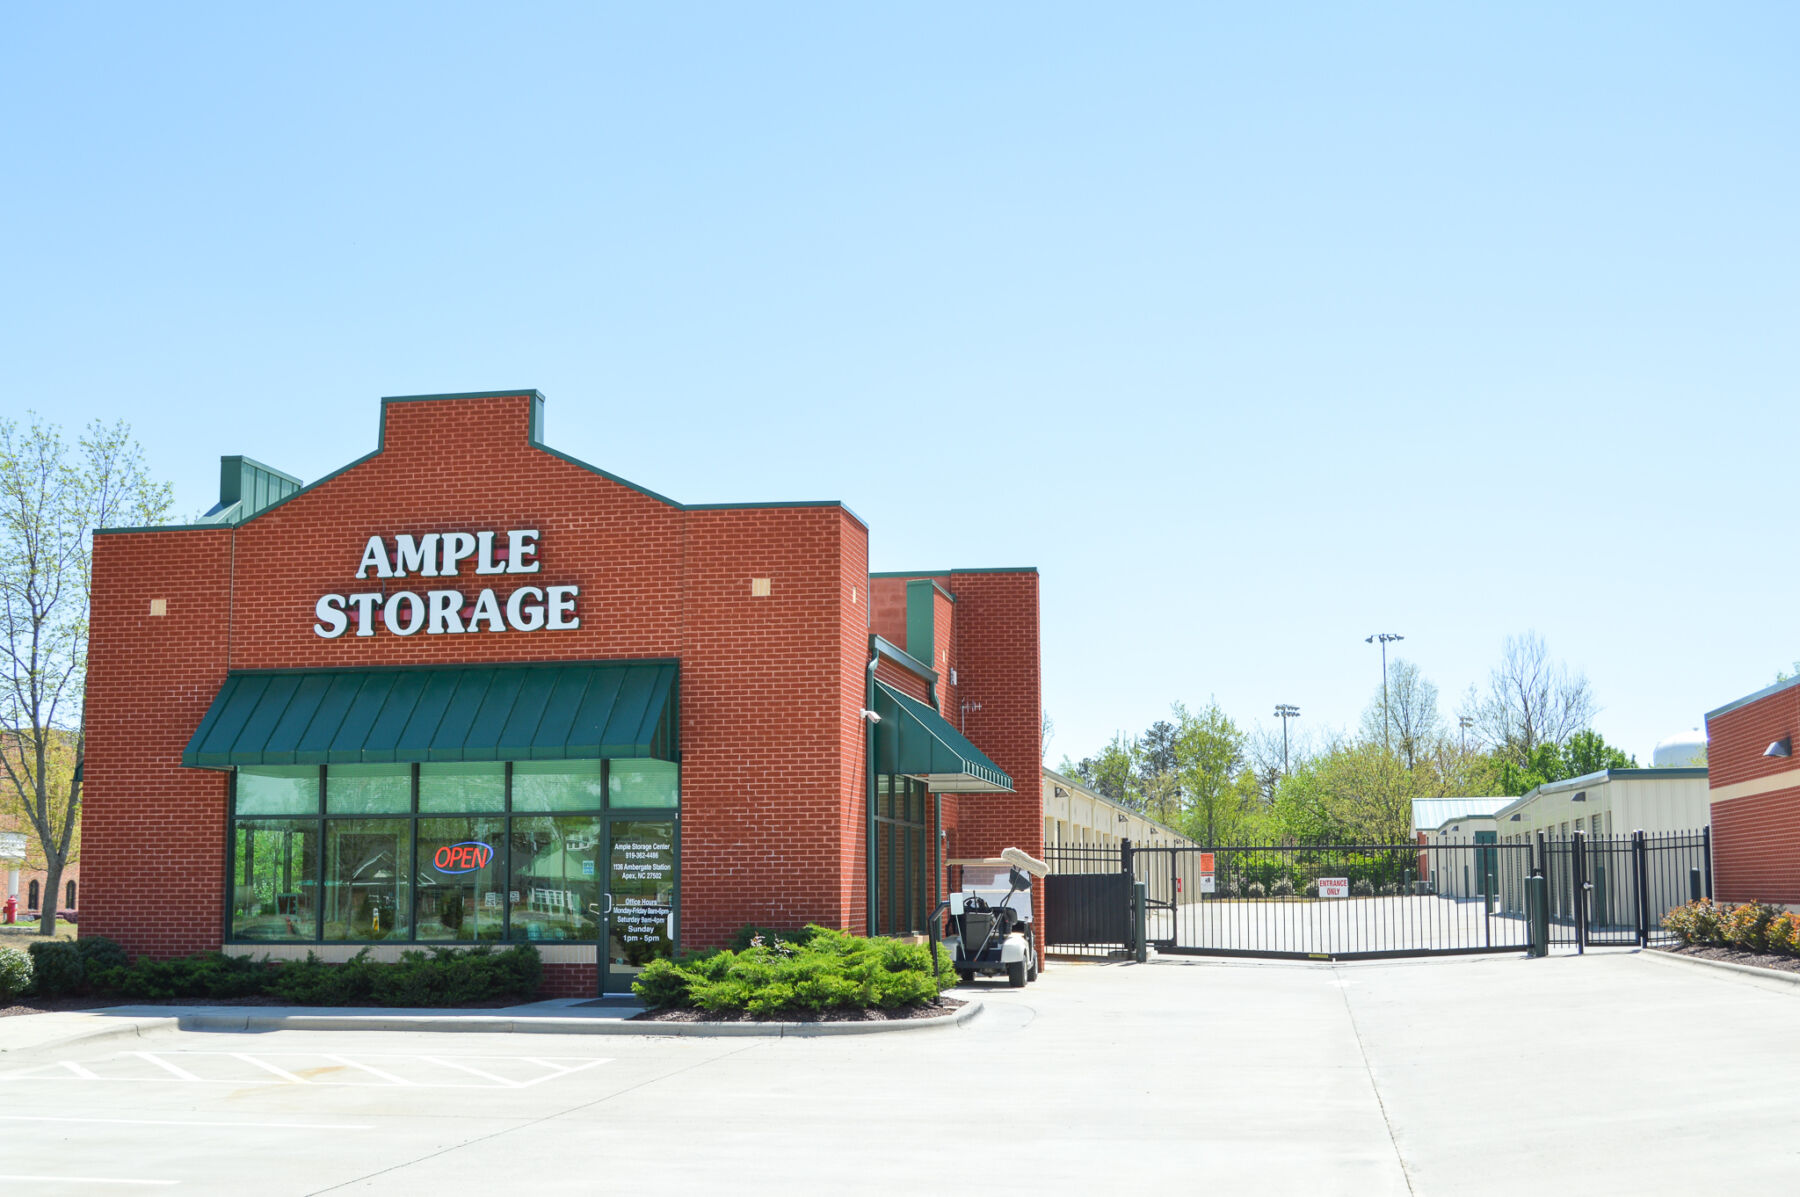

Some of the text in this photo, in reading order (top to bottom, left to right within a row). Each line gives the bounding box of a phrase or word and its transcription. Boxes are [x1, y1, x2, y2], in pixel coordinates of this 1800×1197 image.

[355, 529, 540, 579] AMPLE
[313, 585, 580, 638] STORAGE
[614, 843, 631, 851] Ample
[632, 843, 652, 851] Storage
[434, 846, 489, 869] OPEN
[624, 863, 652, 872] Ambergate
[652, 863, 671, 871] Station
[621, 872, 637, 880] Apex,
[641, 898, 657, 906] Hours
[613, 907, 647, 915] Monday-Friday
[617, 916, 640, 924] Saturday
[628, 925, 654, 934] Sunday
